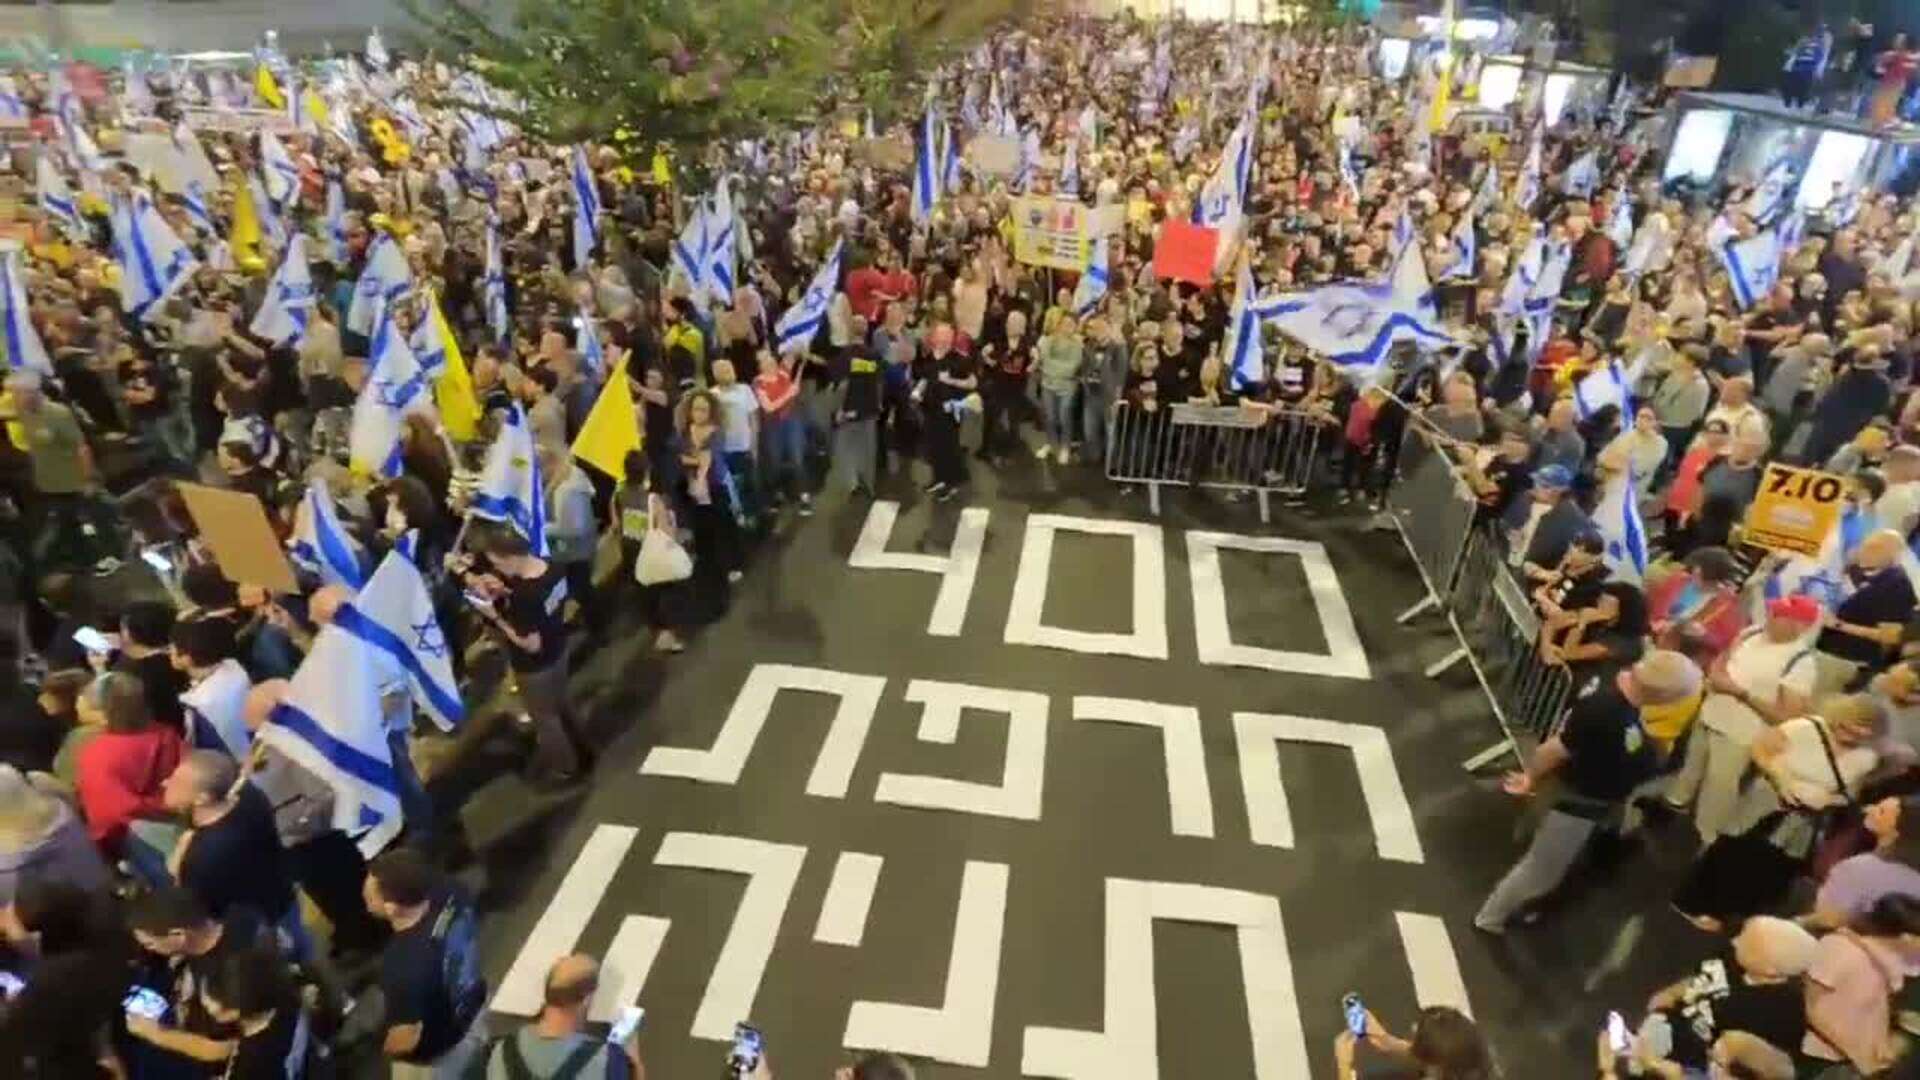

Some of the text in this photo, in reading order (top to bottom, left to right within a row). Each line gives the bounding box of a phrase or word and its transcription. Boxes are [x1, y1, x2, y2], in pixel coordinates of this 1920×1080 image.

[1767, 467, 1841, 503] 7.10
[849, 501, 1370, 679] 400
[640, 664, 1425, 865] חרפת
